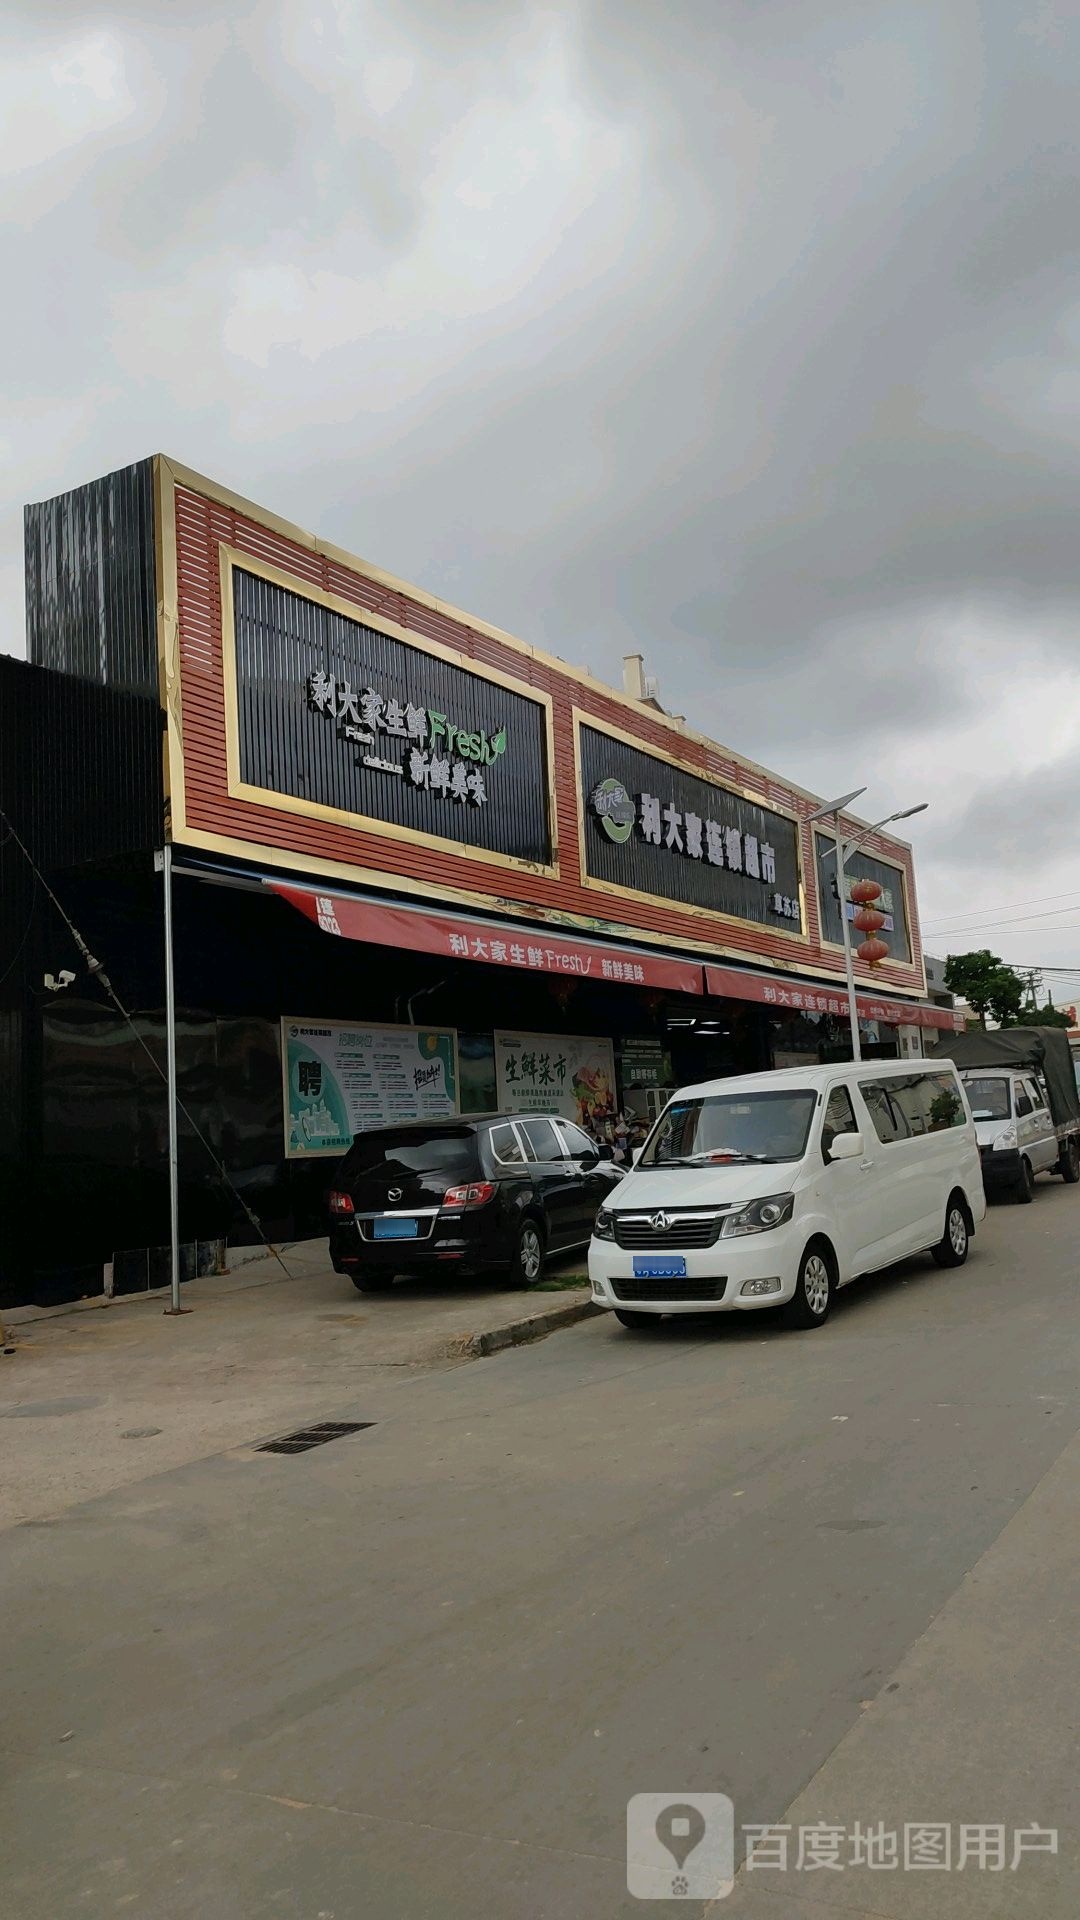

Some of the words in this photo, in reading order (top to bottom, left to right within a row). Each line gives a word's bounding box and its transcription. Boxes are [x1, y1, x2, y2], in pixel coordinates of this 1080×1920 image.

[311, 671, 428, 749] 利大家生鲜
[427, 709, 503, 767] Fresh
[410, 747, 488, 807] 新鲜美味
[639, 792, 776, 884] 利大家连锁超市
[449, 933, 544, 967] 利大家生鲜
[545, 950, 591, 975] Fresh
[601, 958, 645, 982] 新鲜美味
[763, 985, 849, 1017] 利大家连锁超市
[298, 1060, 322, 1097] 聘
[505, 1051, 567, 1086] 生鲜菜市
